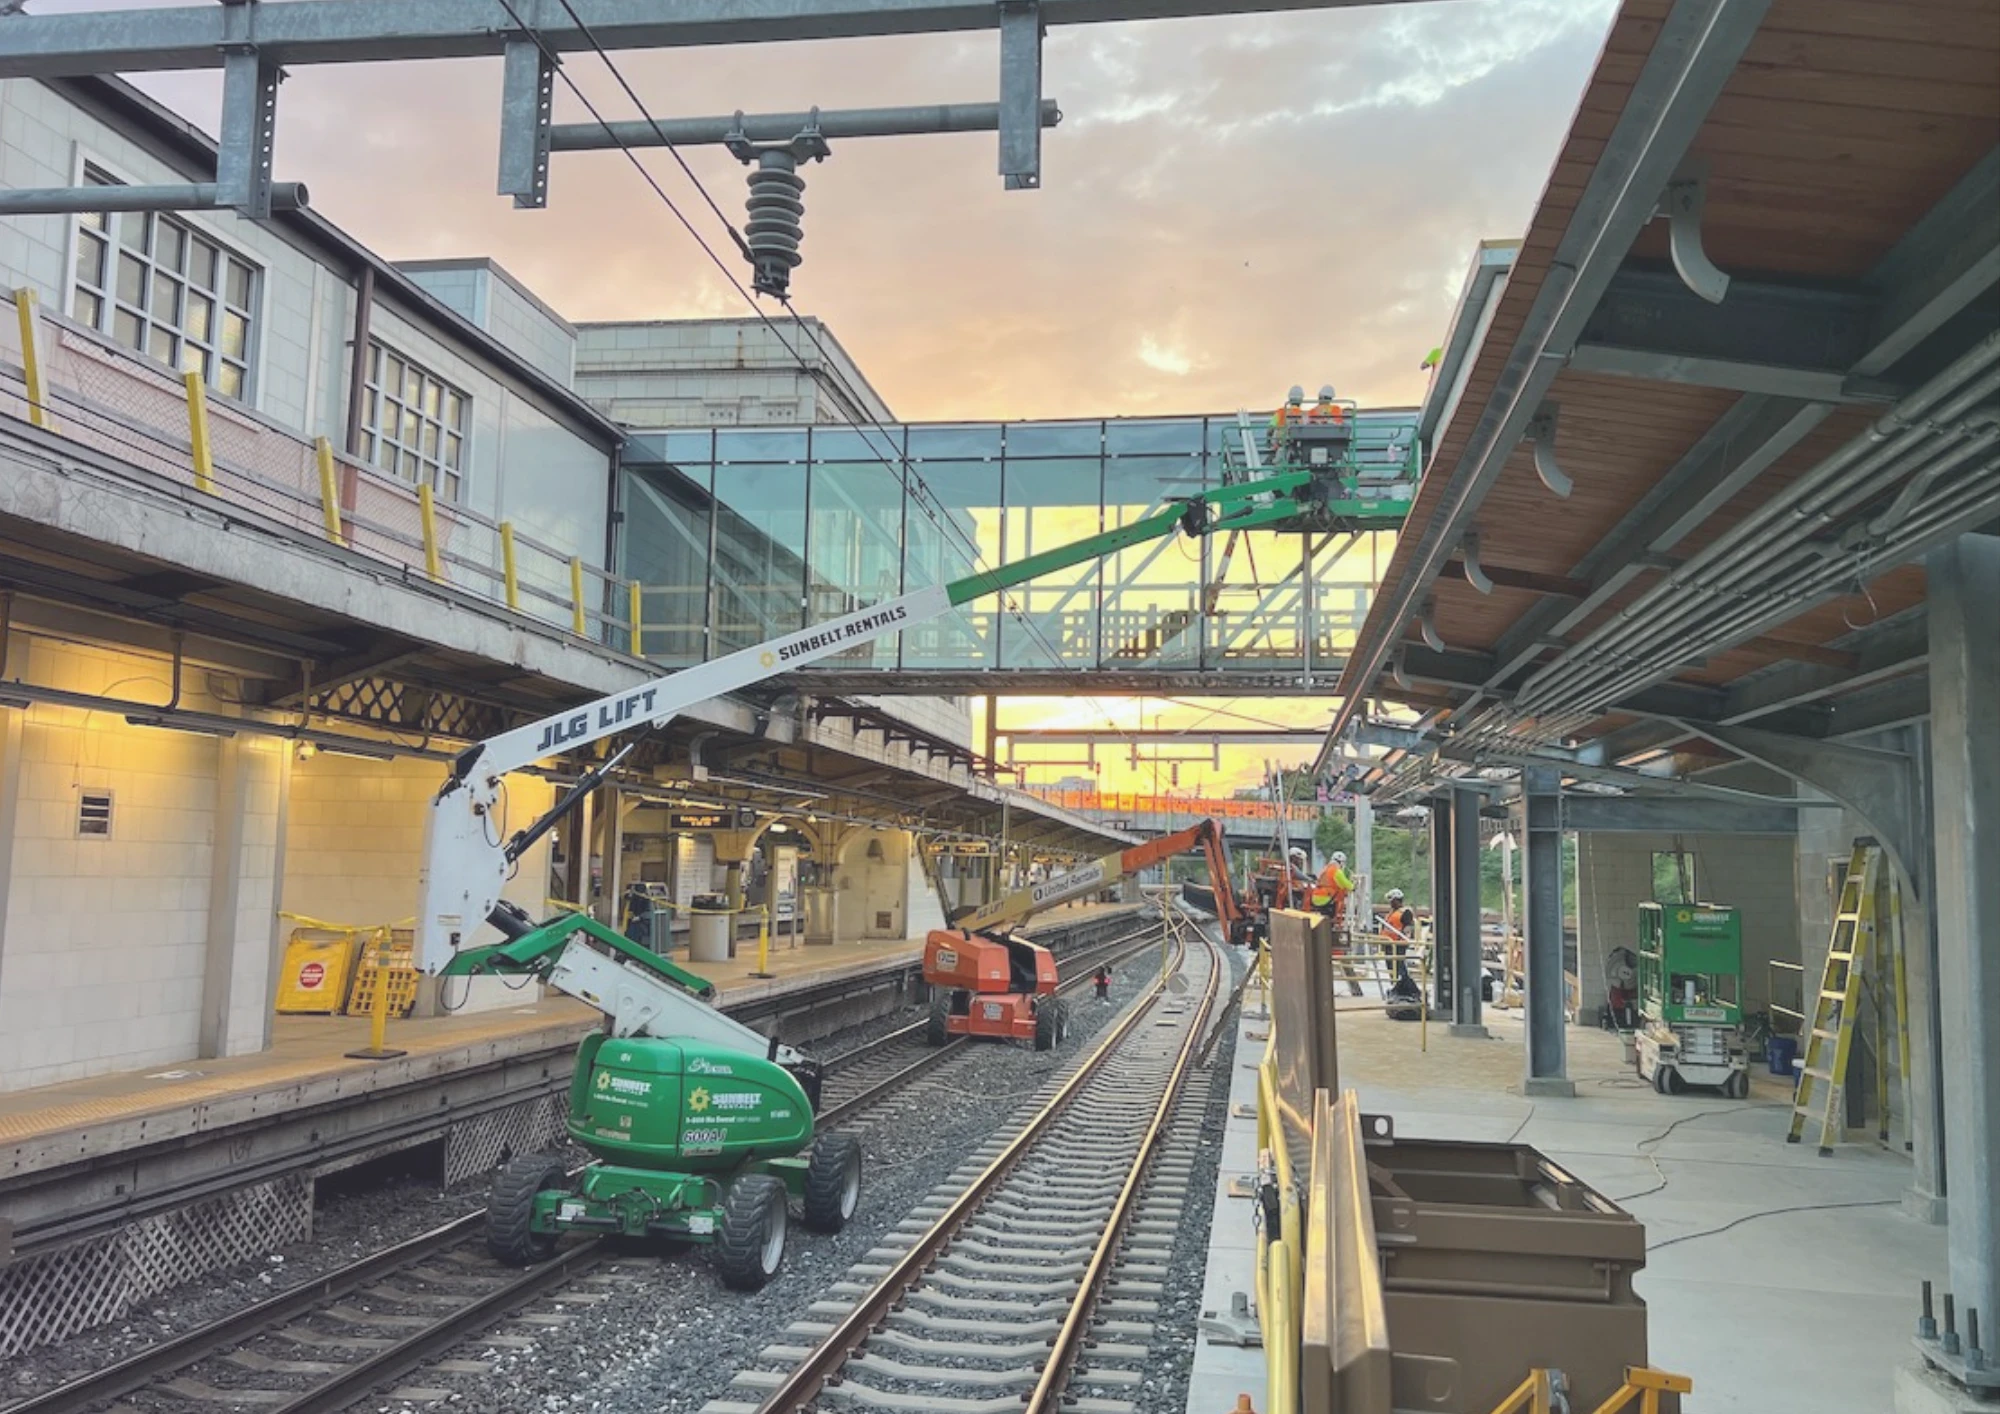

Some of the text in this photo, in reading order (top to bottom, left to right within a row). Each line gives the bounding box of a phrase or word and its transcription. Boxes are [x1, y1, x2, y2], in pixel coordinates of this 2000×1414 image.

[778, 606, 907, 661] SUNBELT RENTALS
[537, 688, 657, 752] JLG LIFT
[1044, 867, 1100, 897] United Rentals
[711, 1093, 762, 1105] SUNBELT
